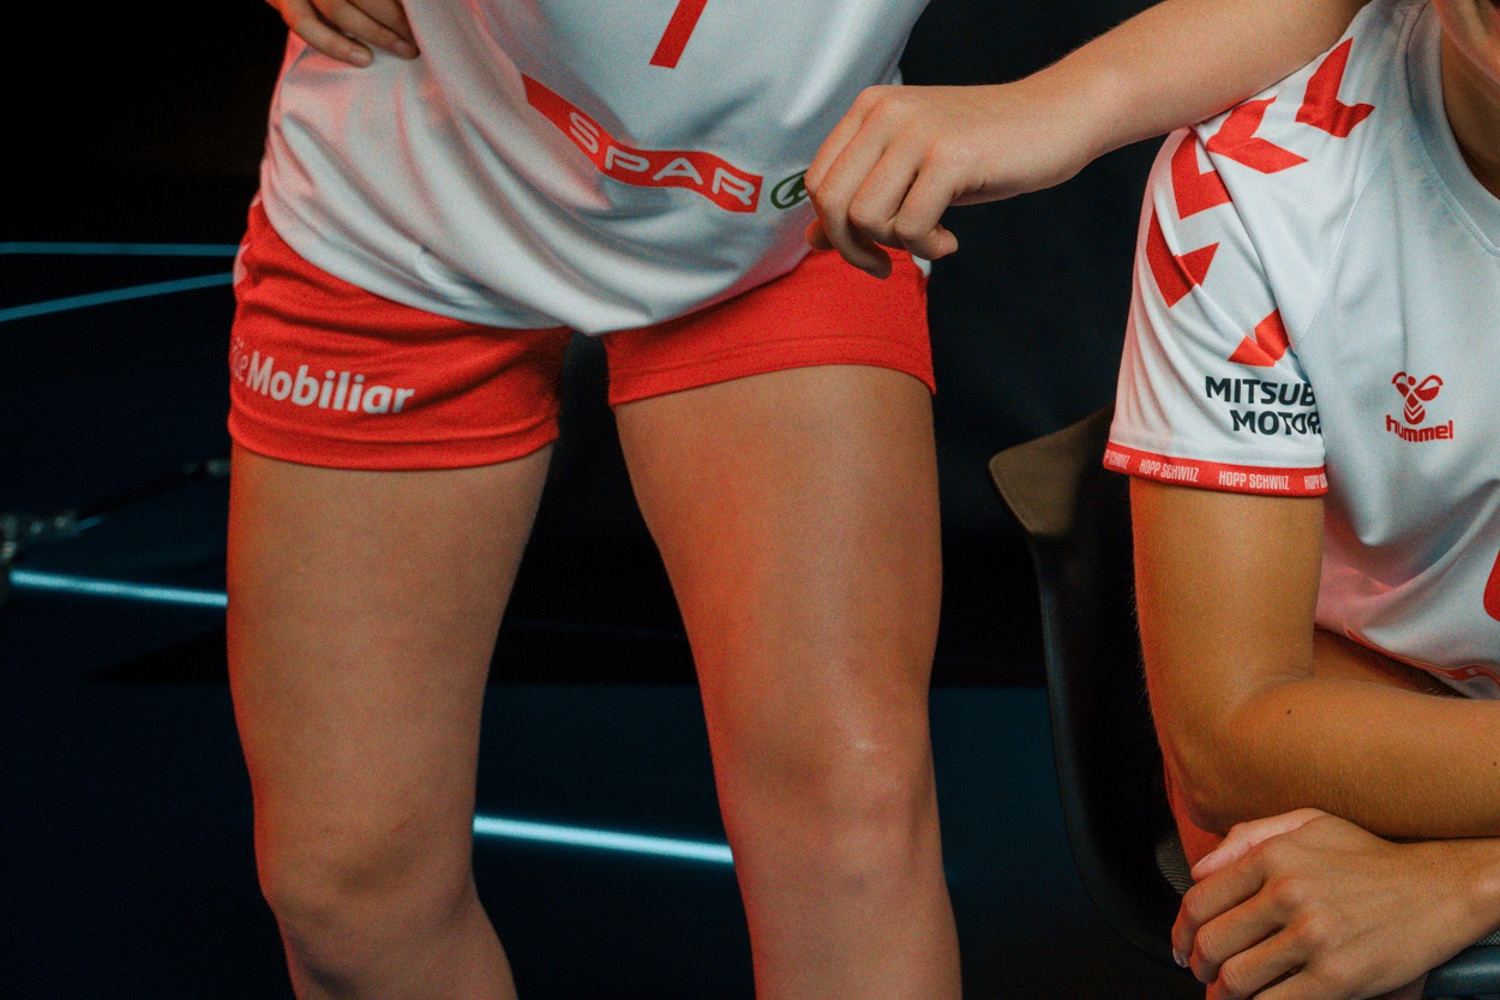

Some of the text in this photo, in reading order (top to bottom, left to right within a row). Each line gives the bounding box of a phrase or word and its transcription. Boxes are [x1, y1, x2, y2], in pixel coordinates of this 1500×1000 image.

[569, 112, 756, 206] SPAR
[246, 351, 415, 414] Mobiliar
[1230, 409, 1322, 435] MOTOR
[1386, 414, 1454, 442] hummel
[1218, 471, 1247, 488] HOPP
